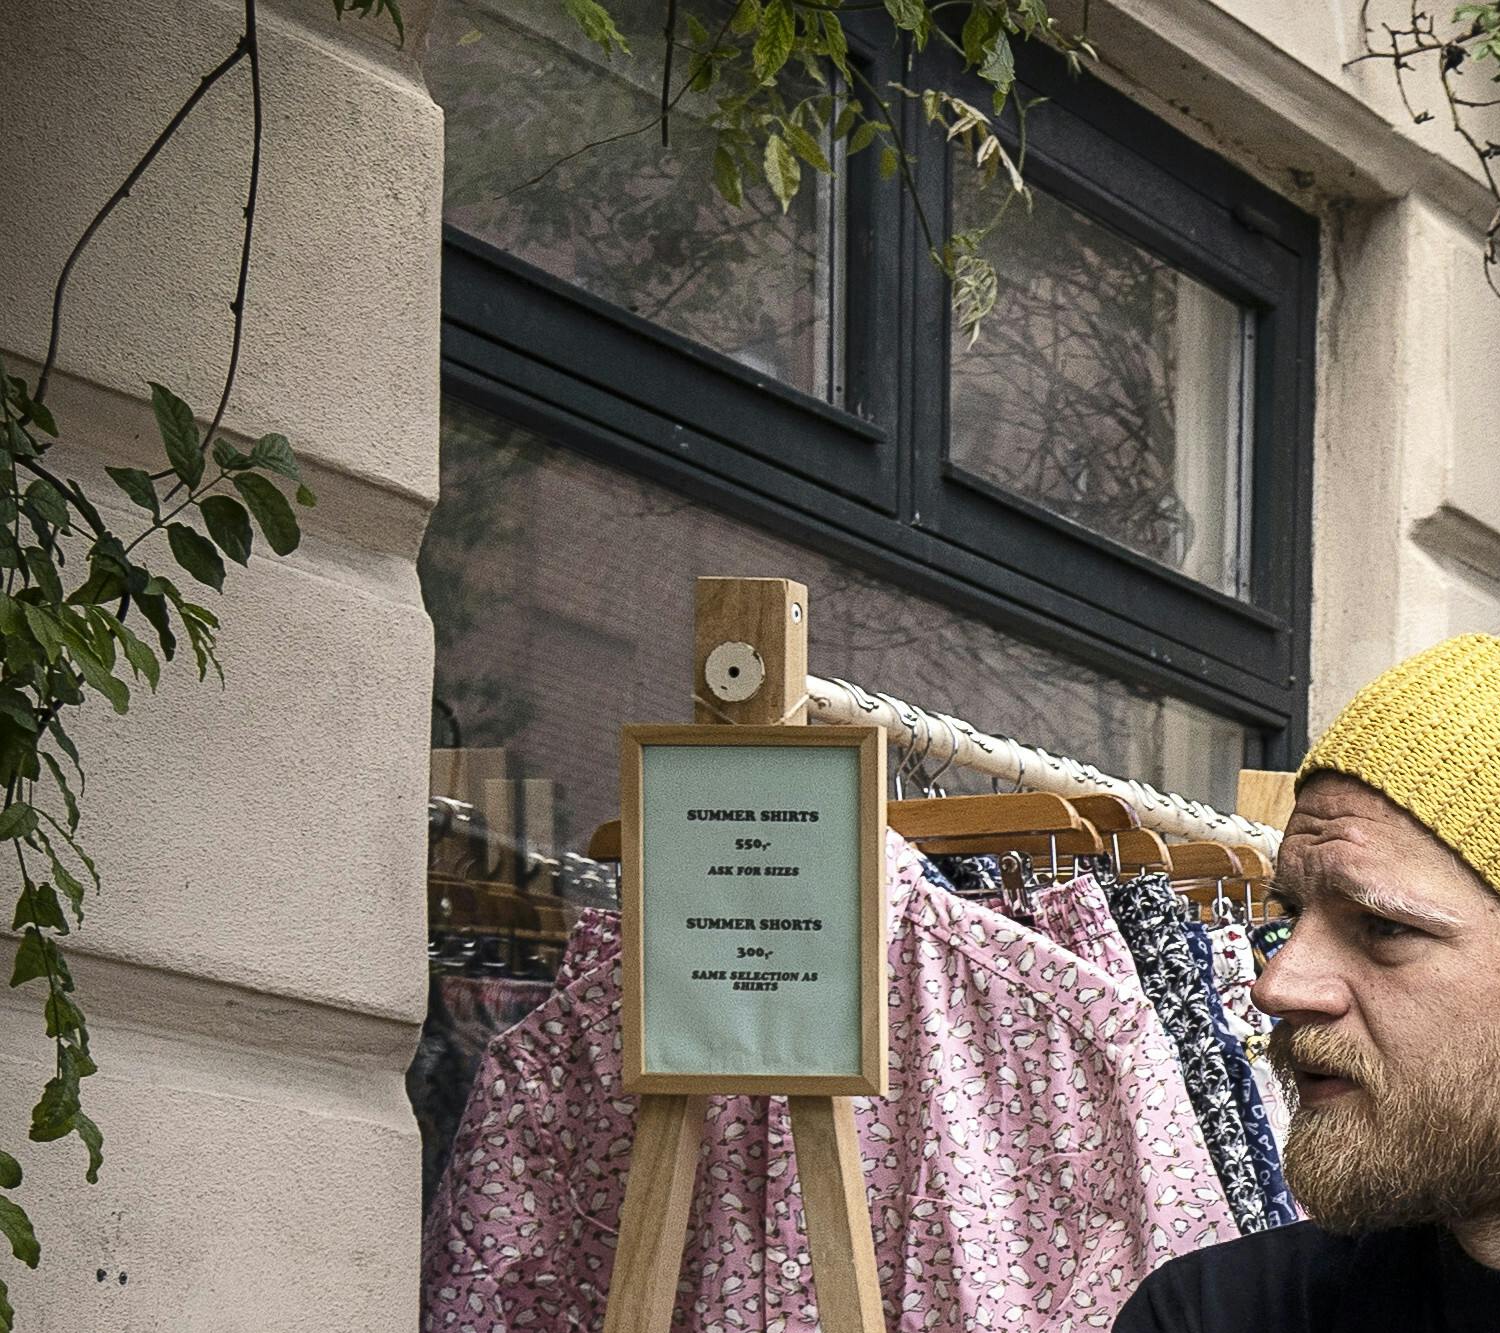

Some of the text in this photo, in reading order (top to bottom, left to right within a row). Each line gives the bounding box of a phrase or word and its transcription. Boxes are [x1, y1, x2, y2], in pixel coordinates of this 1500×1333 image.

[687, 810, 819, 823] SUMMER SHIRTS
[708, 866, 800, 876] ASK FOR SIZES
[686, 918, 823, 931] SUMMER SHORTS
[692, 971, 818, 982] SAME SELECTION AS
[733, 982, 778, 991] SHIRTS
